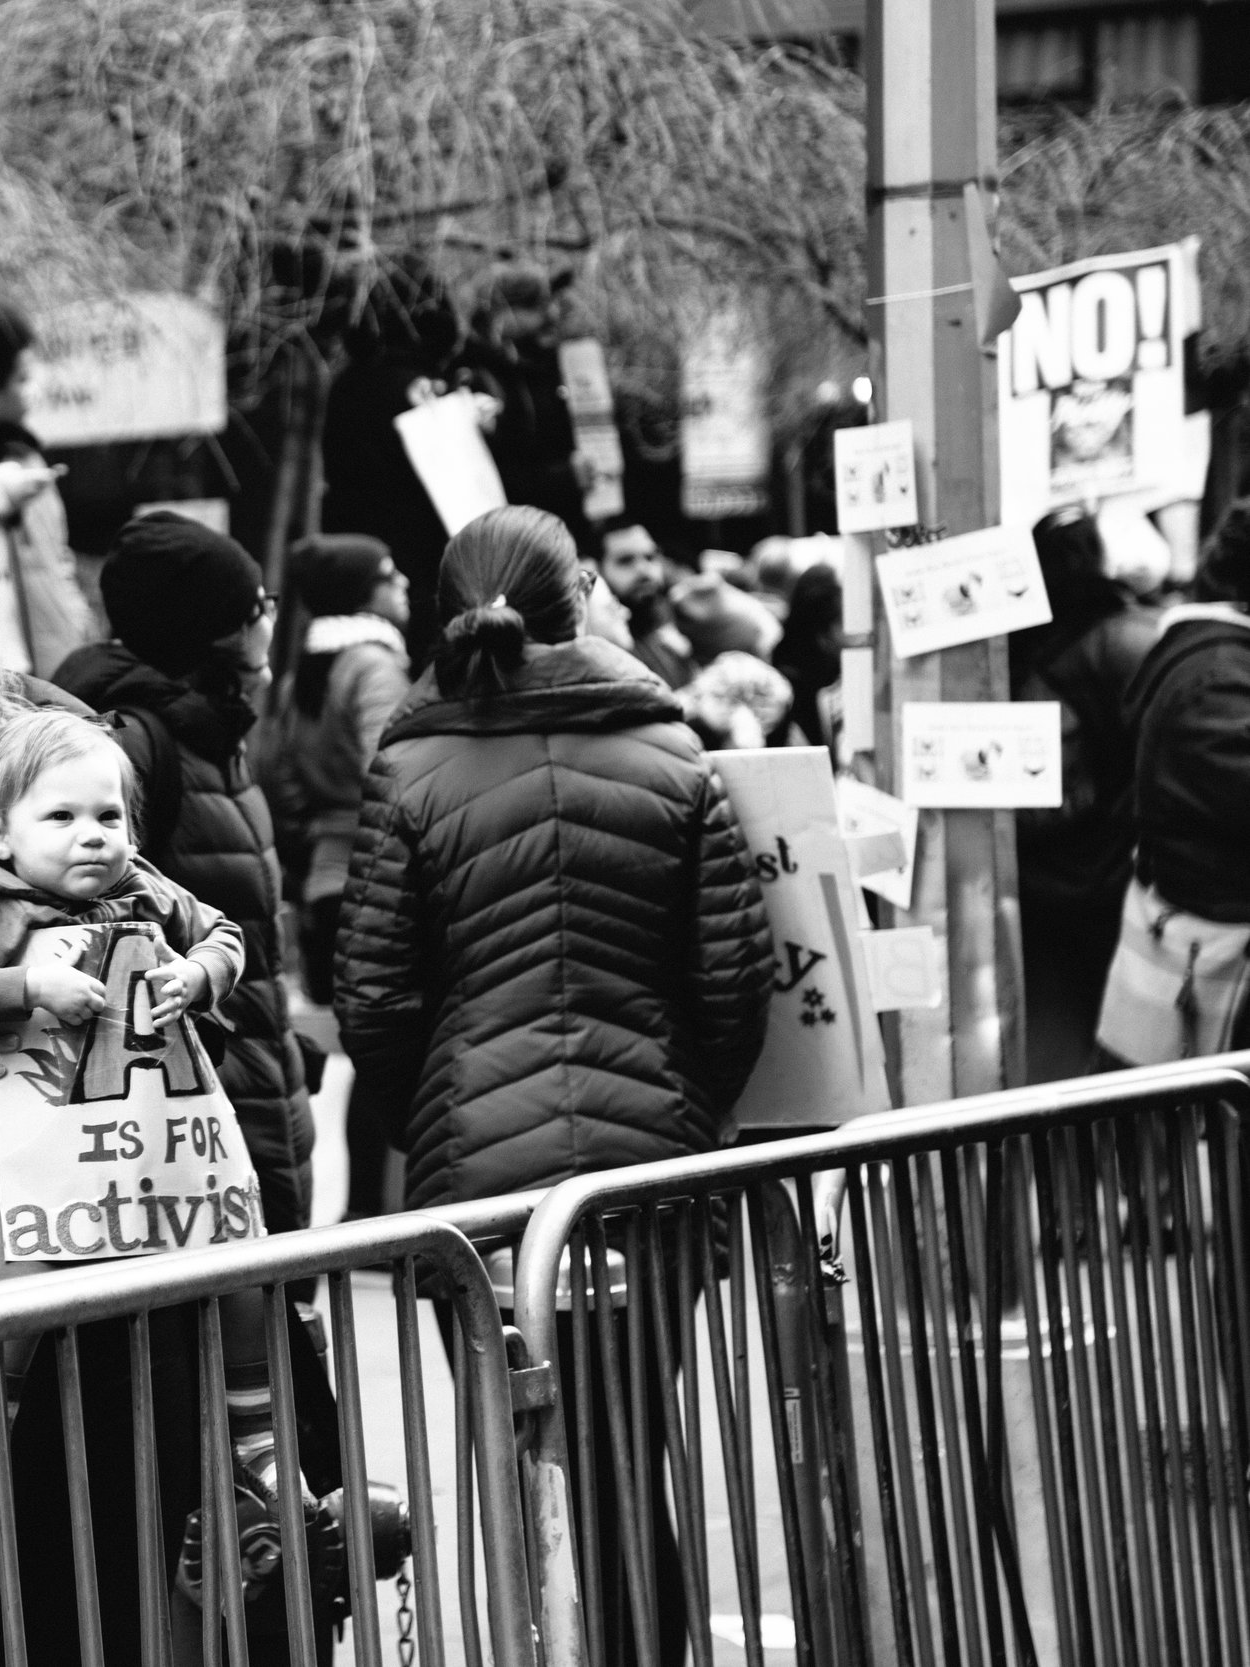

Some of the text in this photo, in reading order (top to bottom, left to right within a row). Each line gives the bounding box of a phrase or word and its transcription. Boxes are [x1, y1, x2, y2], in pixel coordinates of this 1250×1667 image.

[1012, 265, 1168, 397] NO!
[69, 927, 215, 1105] A
[78, 1117, 228, 1163] IS FOR
